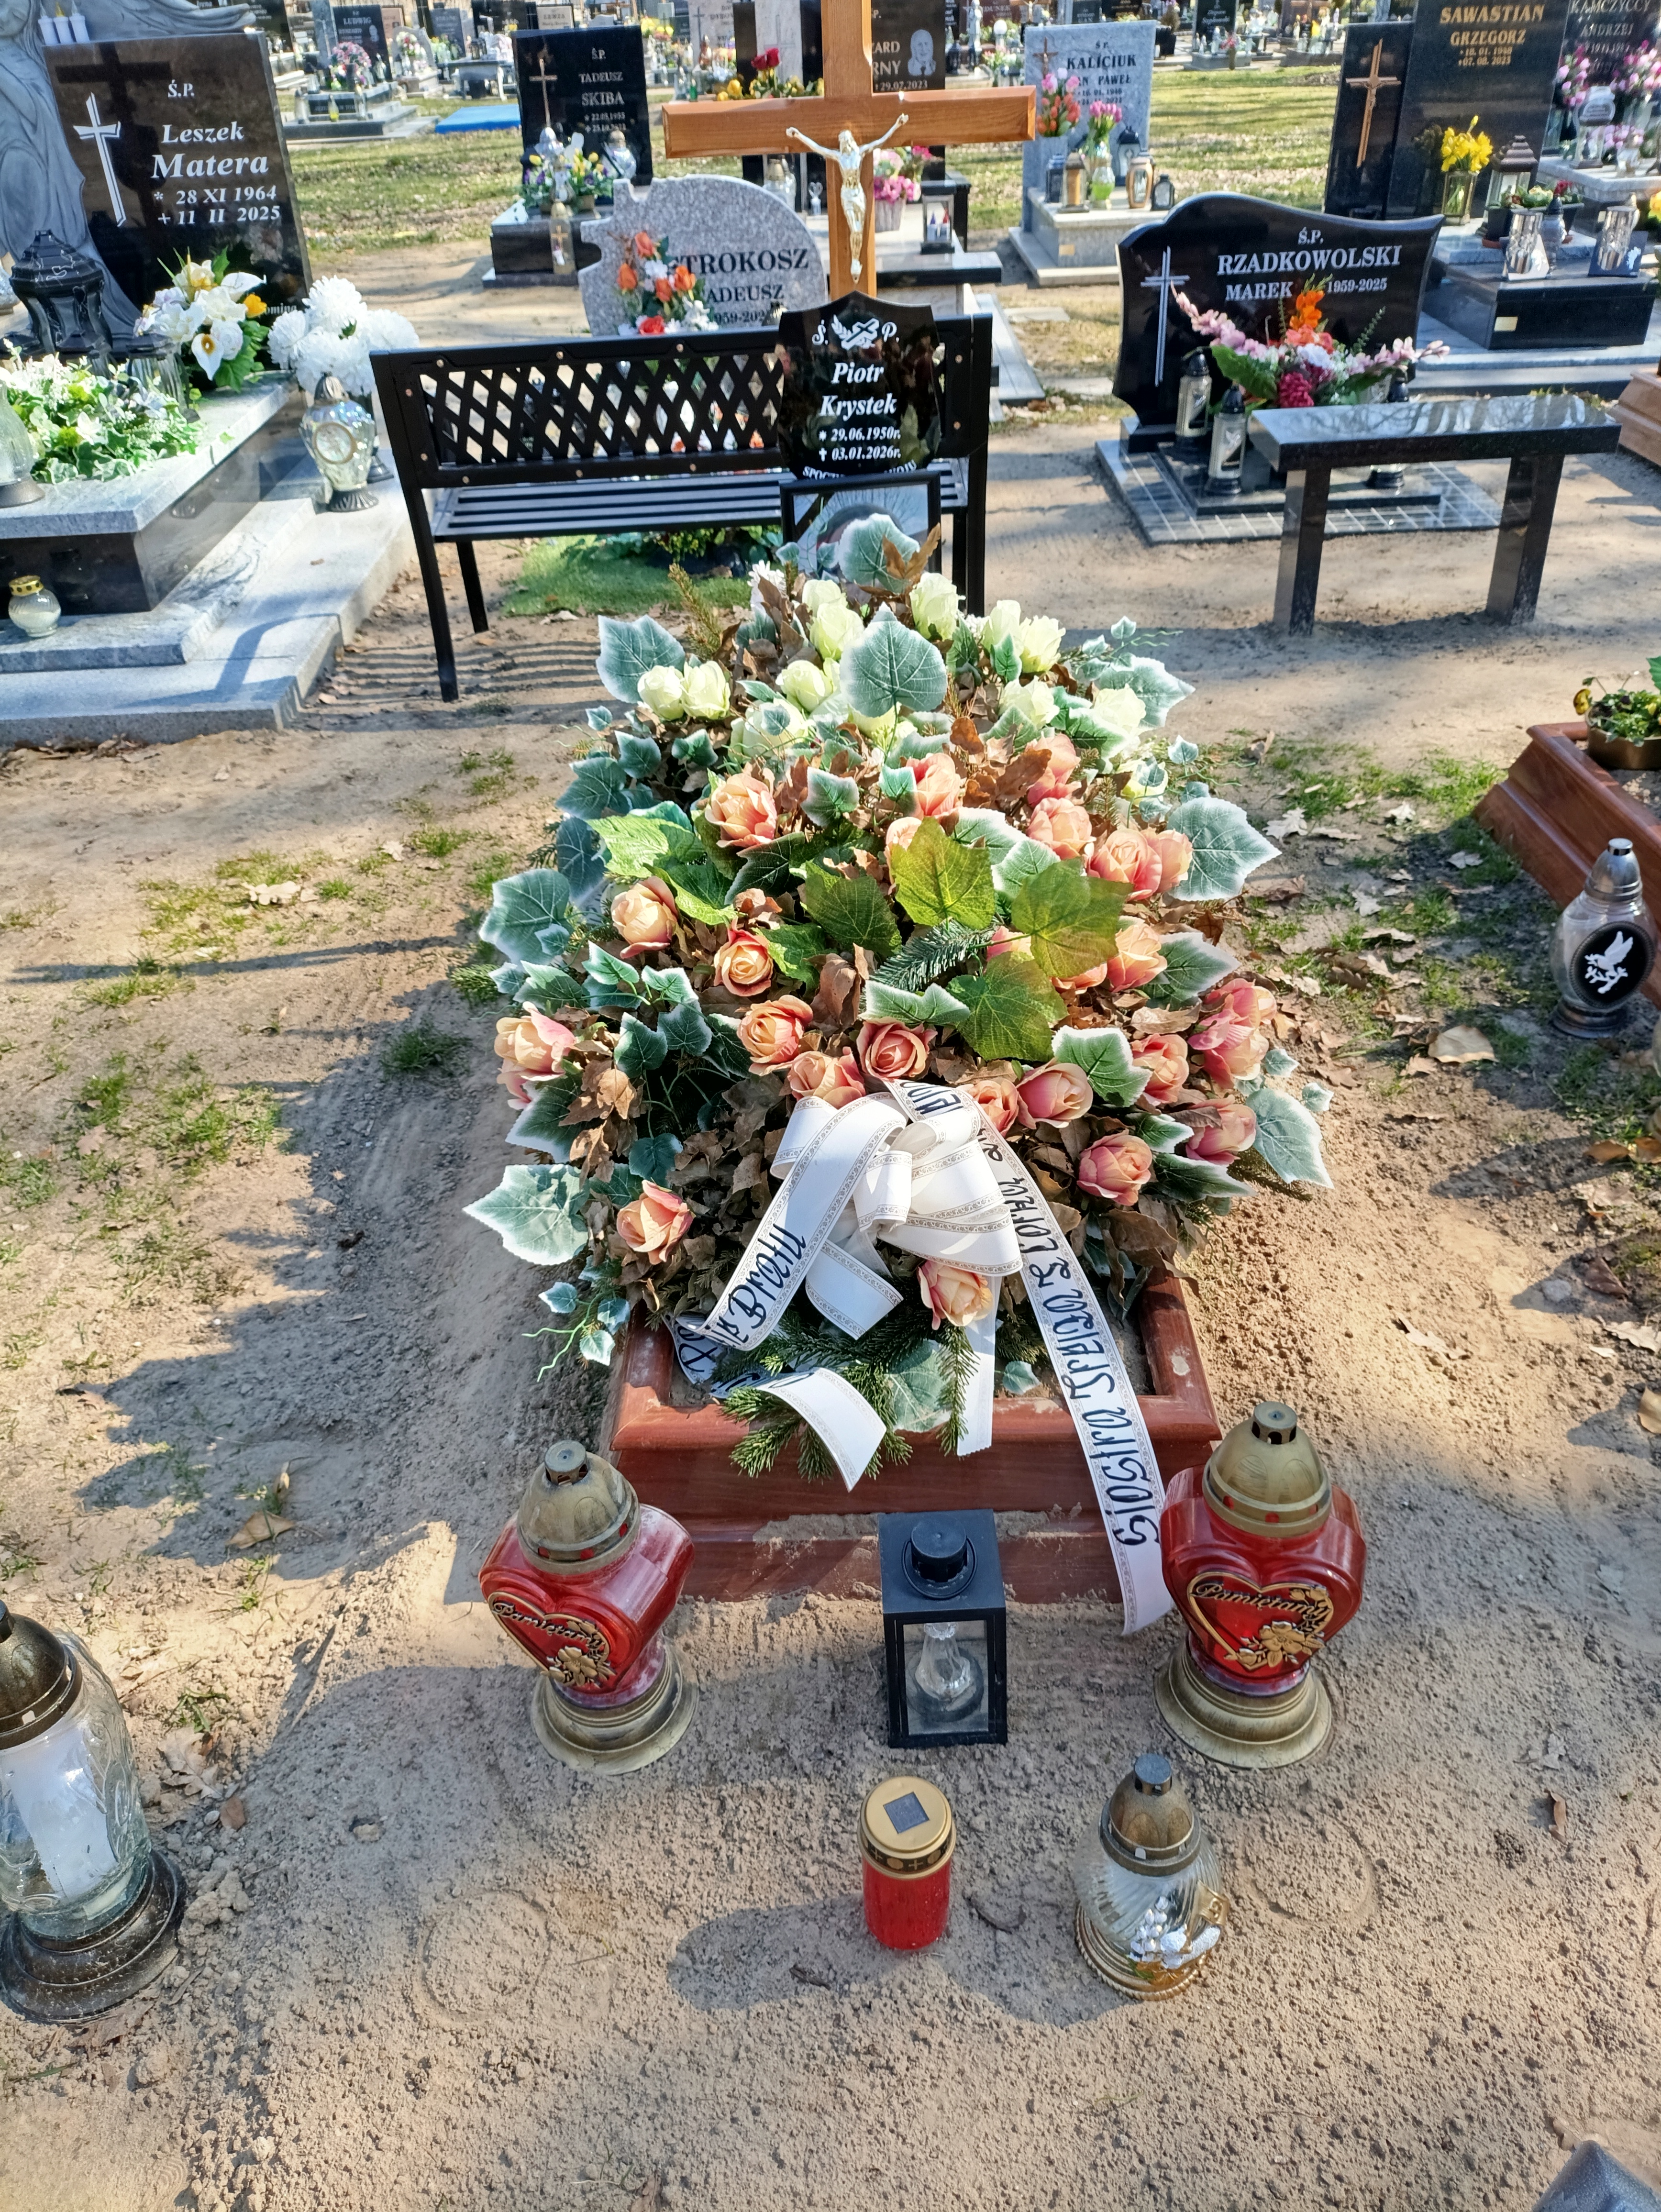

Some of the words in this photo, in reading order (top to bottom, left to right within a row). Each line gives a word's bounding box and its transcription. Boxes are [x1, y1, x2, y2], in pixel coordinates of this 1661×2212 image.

[1440, 4, 1545, 24] SAWASTIAN
[1450, 29, 1526, 46] GRZEGORZ
[1067, 55, 1136, 69] KALICIUK
[578, 72, 623, 83] TADEUSZ
[168, 79, 194, 97] Ś.P.
[581, 91, 625, 106] SKIBA
[161, 121, 244, 143] Leszek
[151, 153, 269, 178] Matera
[176, 189, 197, 204] 28
[203, 188, 227, 203] XI
[234, 185, 277, 201] 1964
[178, 210, 195, 224] 11
[209, 209, 225, 223] II
[237, 206, 280, 221] 2025
[1298, 227, 1324, 244] Ś.P.
[674, 249, 808, 274] TROKOSZ
[1217, 245, 1402, 276] RZADKOWOLSKI
[707, 285, 784, 302] ADEUSZ
[1225, 281, 1294, 301] MAREK
[1327, 277, 1387, 294] 1959-2025
[830, 362, 884, 384] Piotr
[819, 393, 897, 421] Krystek
